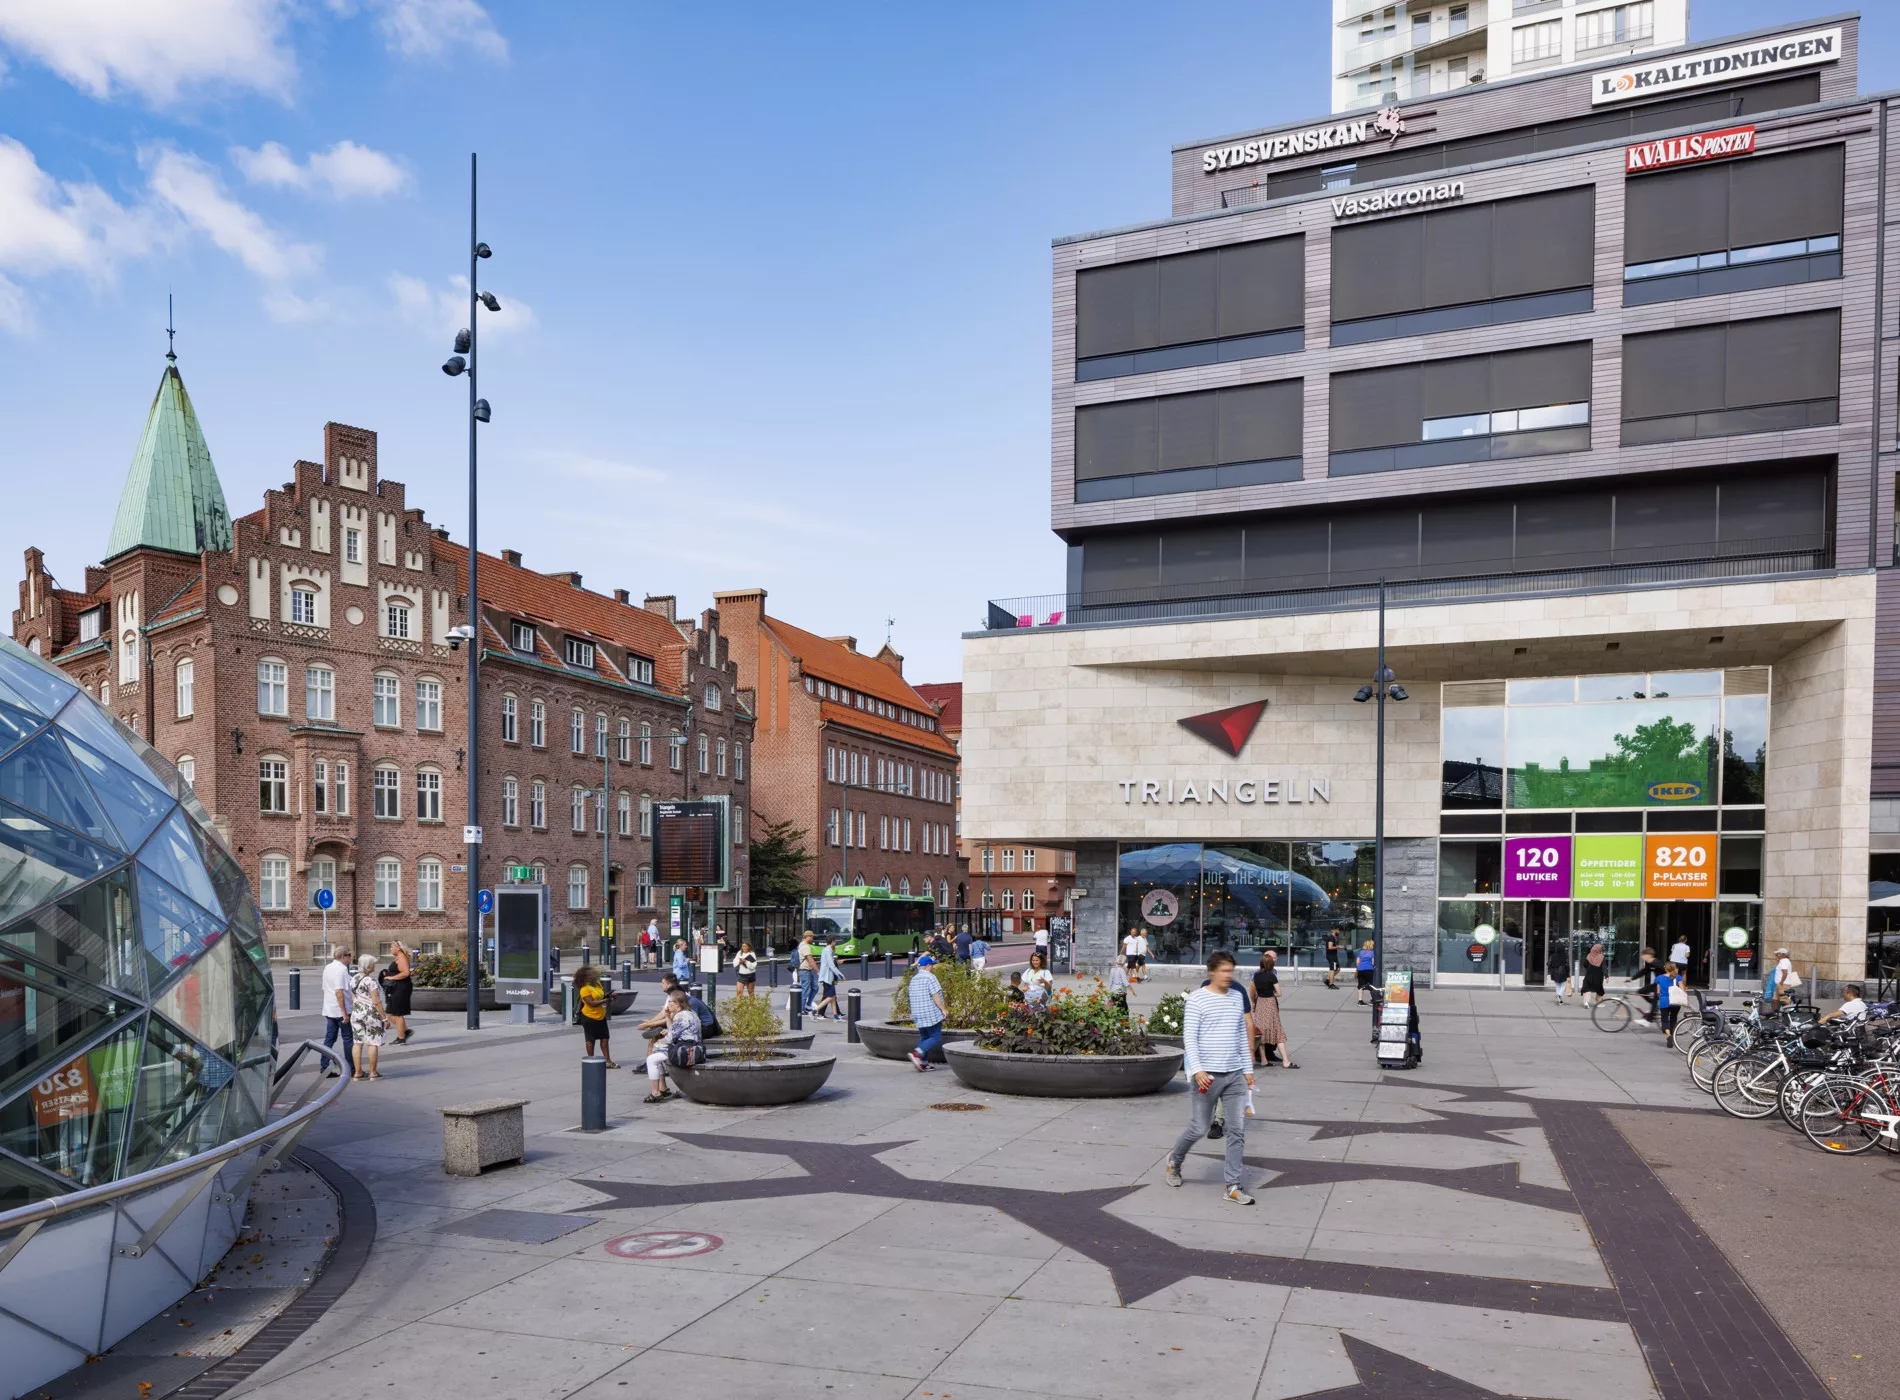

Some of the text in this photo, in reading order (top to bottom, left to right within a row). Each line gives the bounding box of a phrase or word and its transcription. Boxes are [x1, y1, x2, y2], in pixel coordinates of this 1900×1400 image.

[1601, 35, 1834, 95] LOKALTIDNINGEN
[1203, 120, 1367, 172] SYDSVENSKAN
[1330, 181, 1464, 218] Vasakronan
[1119, 777, 1330, 803] TRIANGELN
[1653, 787, 1697, 795] IKEA
[1516, 847, 1559, 867] 120
[1580, 858, 1636, 867] ÖPPETTIDER
[1655, 846, 1707, 867] 820
[1205, 871, 1225, 885] JOE
[1235, 871, 1254, 885] THE
[1258, 871, 1290, 885] JUICE
[1516, 873, 1558, 881] BUTIKER
[1653, 872, 1708, 880] P-PLATSER
